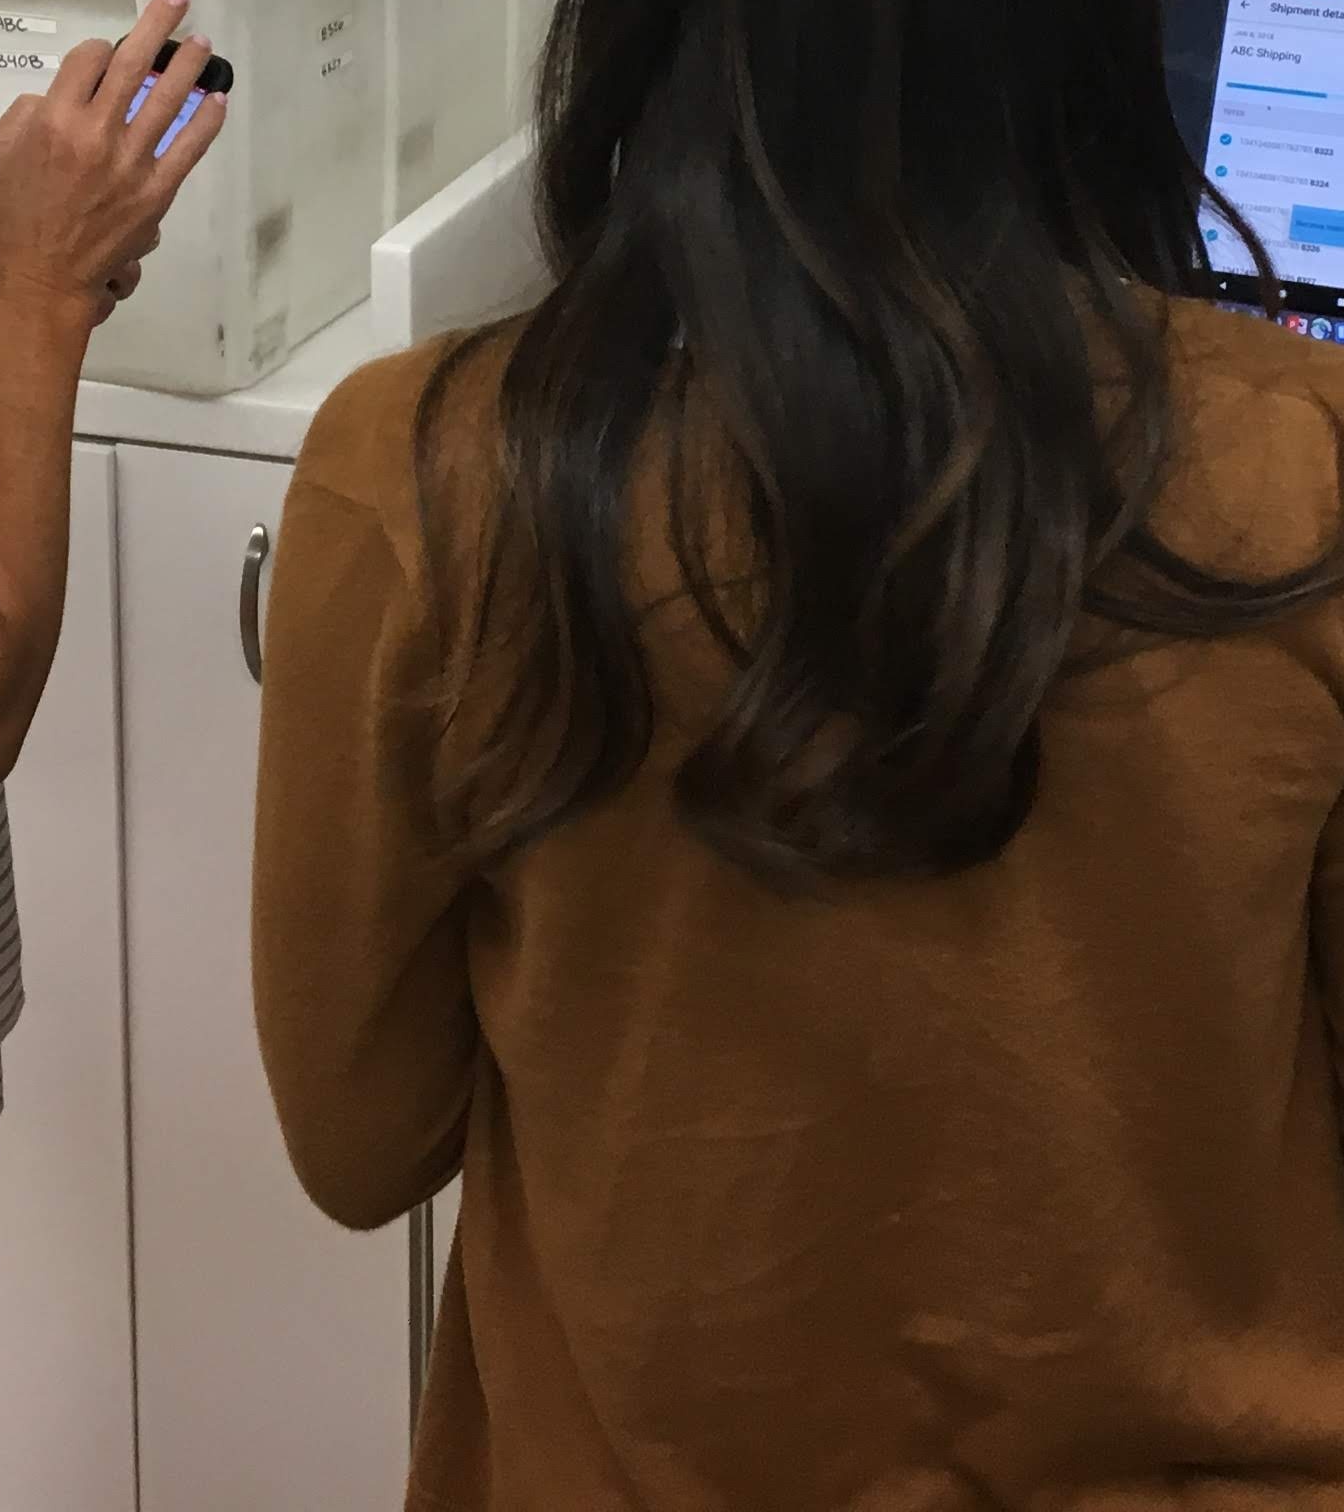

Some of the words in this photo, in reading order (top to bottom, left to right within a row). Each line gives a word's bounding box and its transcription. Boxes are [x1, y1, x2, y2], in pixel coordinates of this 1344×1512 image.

[1270, 2, 1320, 18] Shipment
[1231, 45, 1255, 57] ABC
[1256, 47, 1302, 65] Shipping
